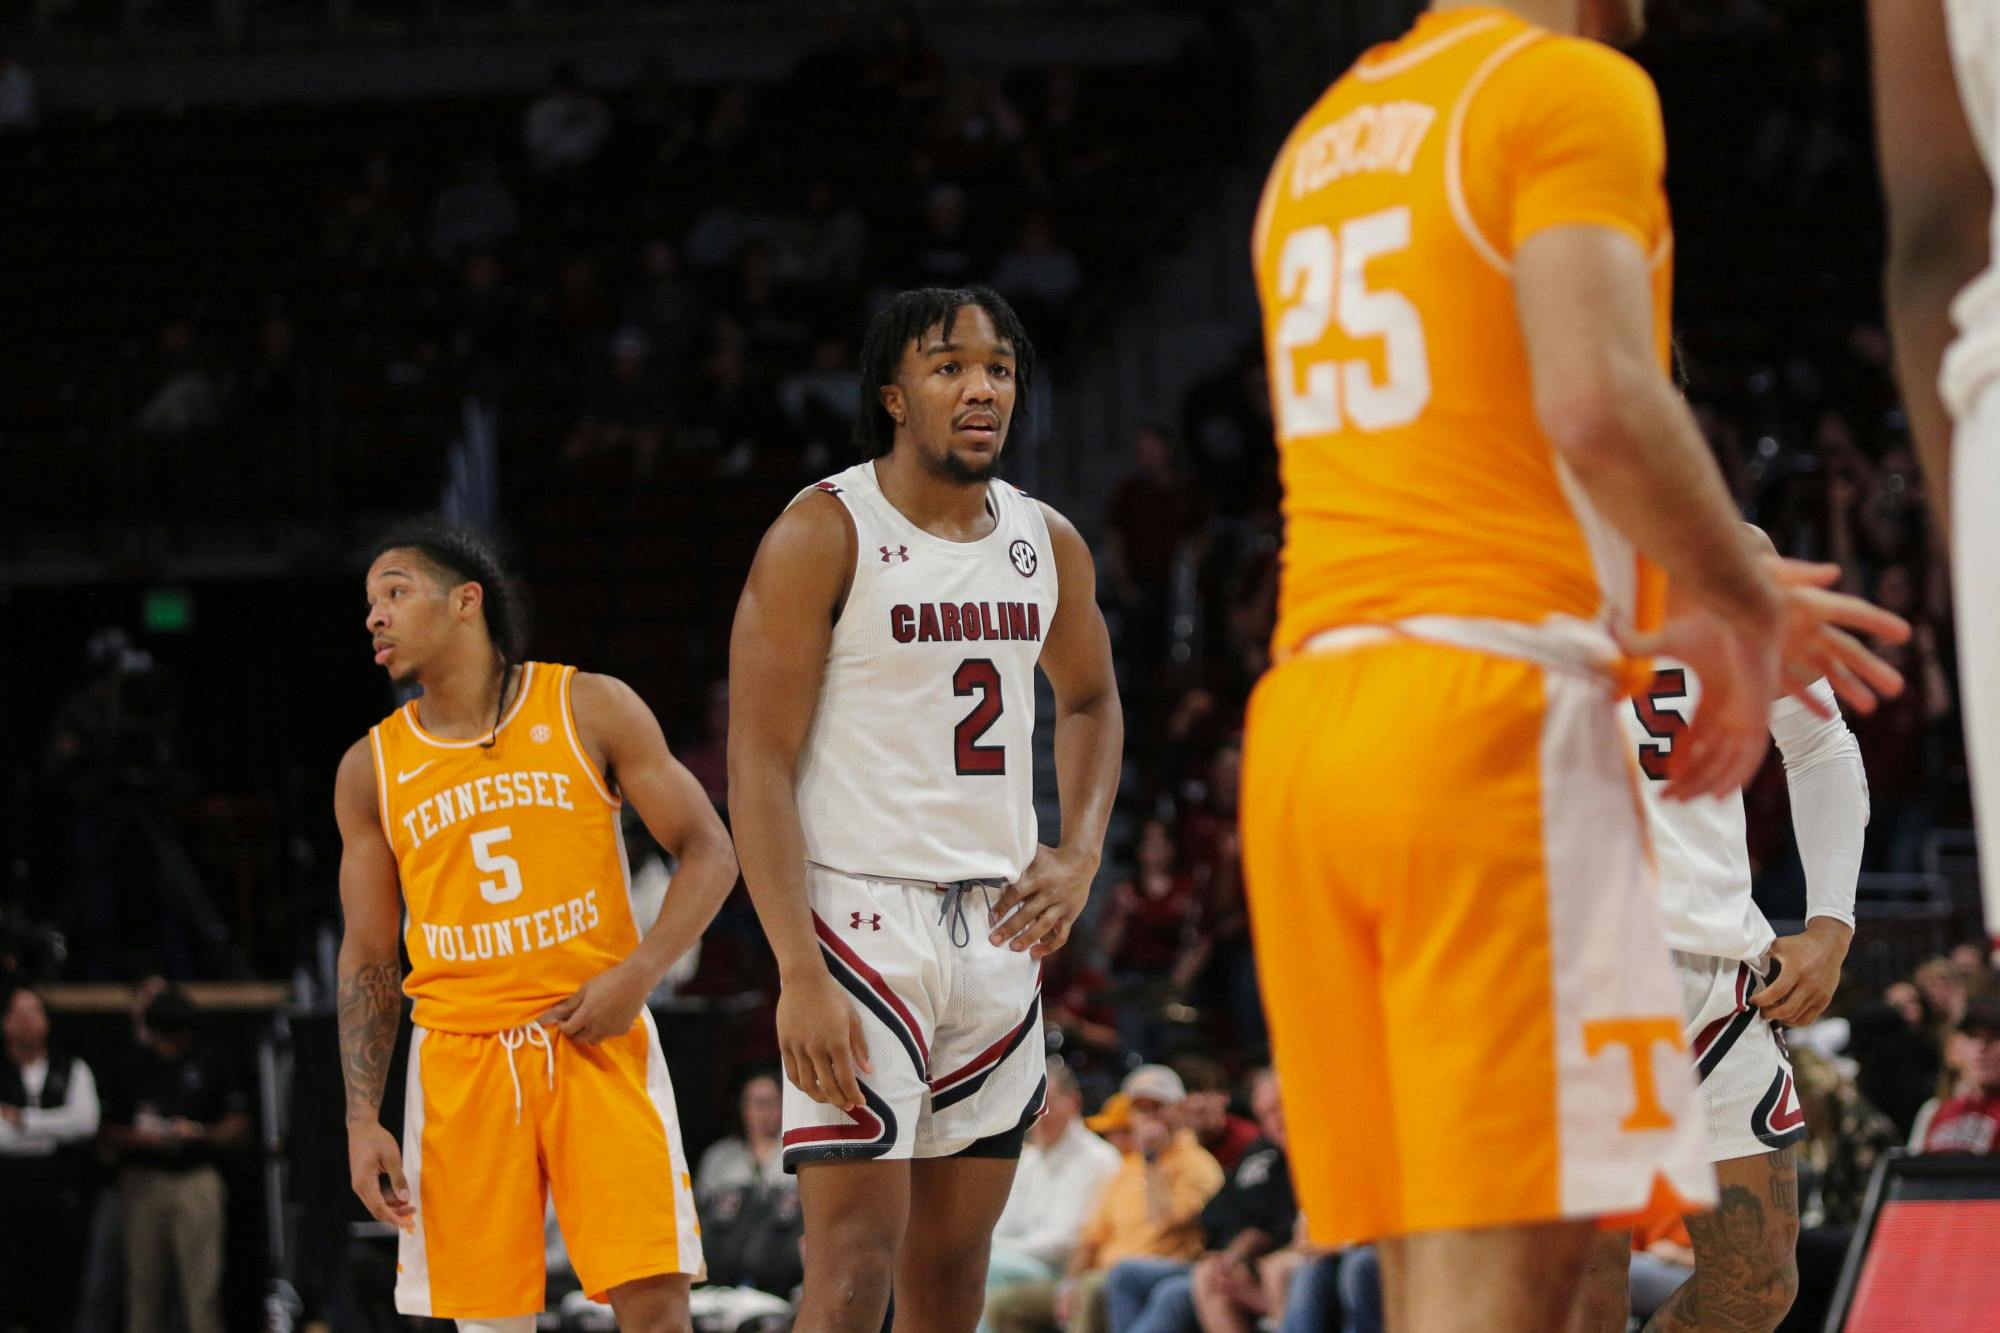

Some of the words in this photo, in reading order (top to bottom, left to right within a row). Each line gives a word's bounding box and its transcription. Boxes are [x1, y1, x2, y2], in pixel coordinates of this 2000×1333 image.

[1275, 204, 1431, 441] 25
[1011, 541, 1036, 575] SEC
[890, 602, 1041, 643] CAROLINA
[952, 658, 1006, 775] 2
[402, 771, 574, 849] TENNESSEE
[469, 825, 523, 905] 5
[421, 888, 600, 961] VOLUNTEERS
[1583, 1016, 1686, 1132] T
